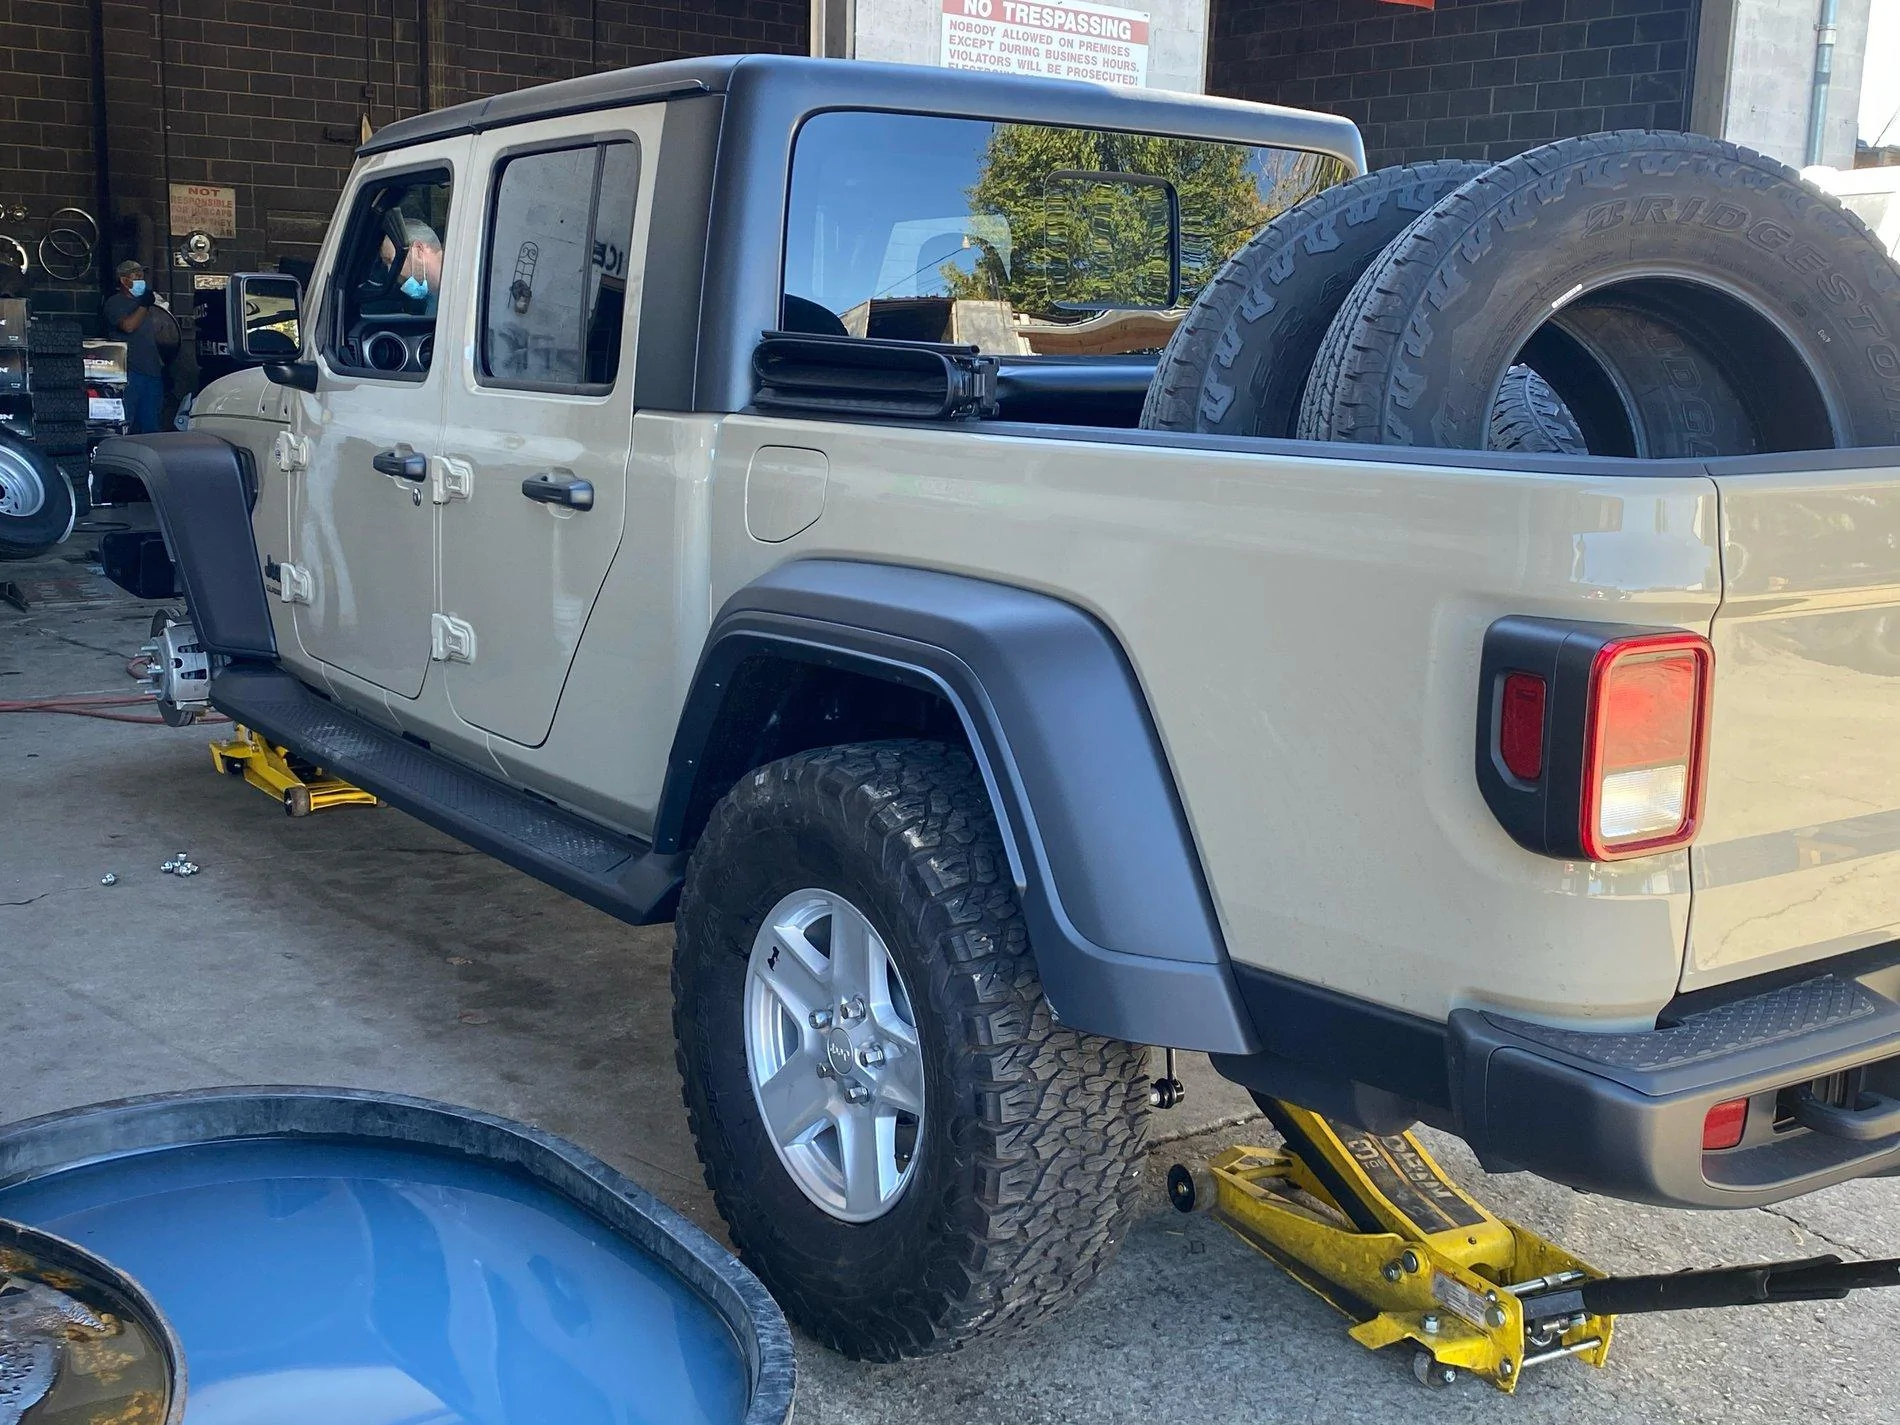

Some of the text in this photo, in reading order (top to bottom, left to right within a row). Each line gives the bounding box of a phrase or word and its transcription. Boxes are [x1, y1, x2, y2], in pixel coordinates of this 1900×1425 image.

[950, 20, 1130, 57] NOBODY ALLOWED ON PREMISES
[963, 0, 1132, 41] NO TRESPASSING
[949, 34, 1139, 72] EXCEPT DURING BUSINESS HOURS.
[949, 48, 1011, 67] VIOLATORS
[1017, 58, 1042, 72] WILL
[1047, 63, 1062, 75] BE
[1067, 65, 1138, 86] PROSECUTED!
[170, 195, 232, 208] RESPONSIBLE
[188, 187, 221, 197] NOT
